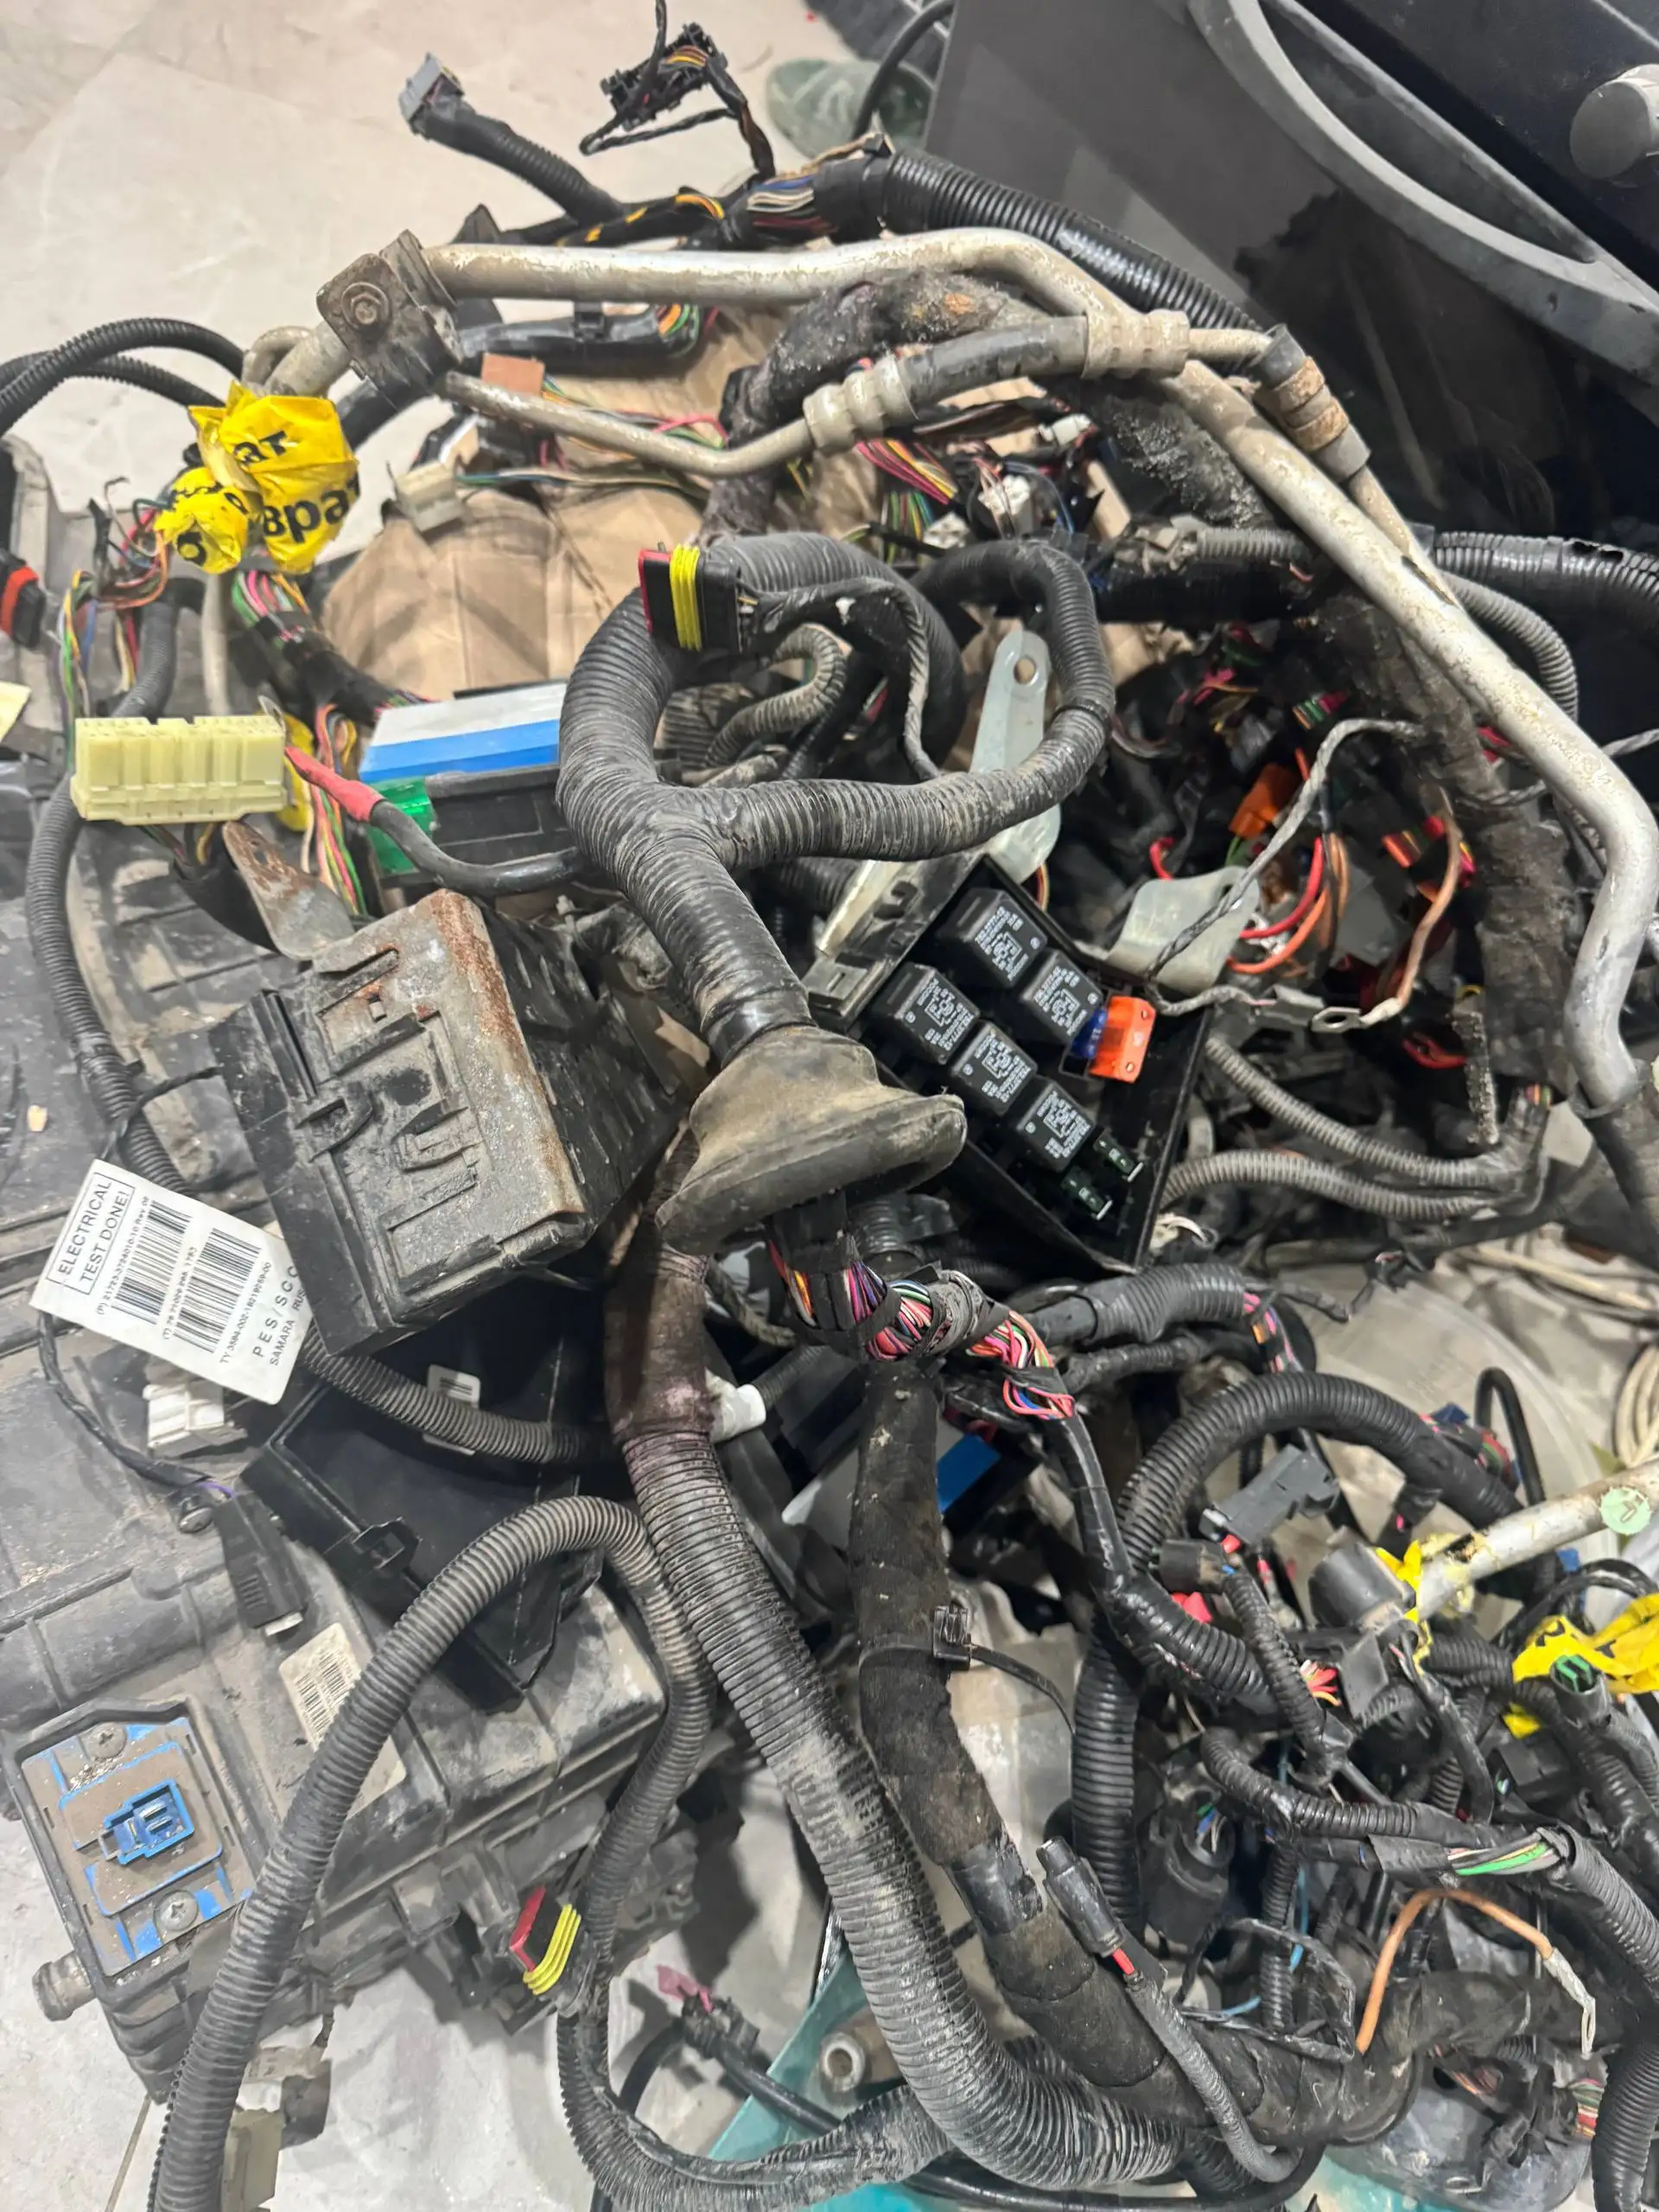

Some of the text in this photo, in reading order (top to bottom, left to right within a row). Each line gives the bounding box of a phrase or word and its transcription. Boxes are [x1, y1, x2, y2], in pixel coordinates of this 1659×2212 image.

[58, 1181, 112, 1275] ELECTRICAL
[79, 1190, 130, 1281] TEST DONE!
[269, 1319, 296, 1366] SAMARA
